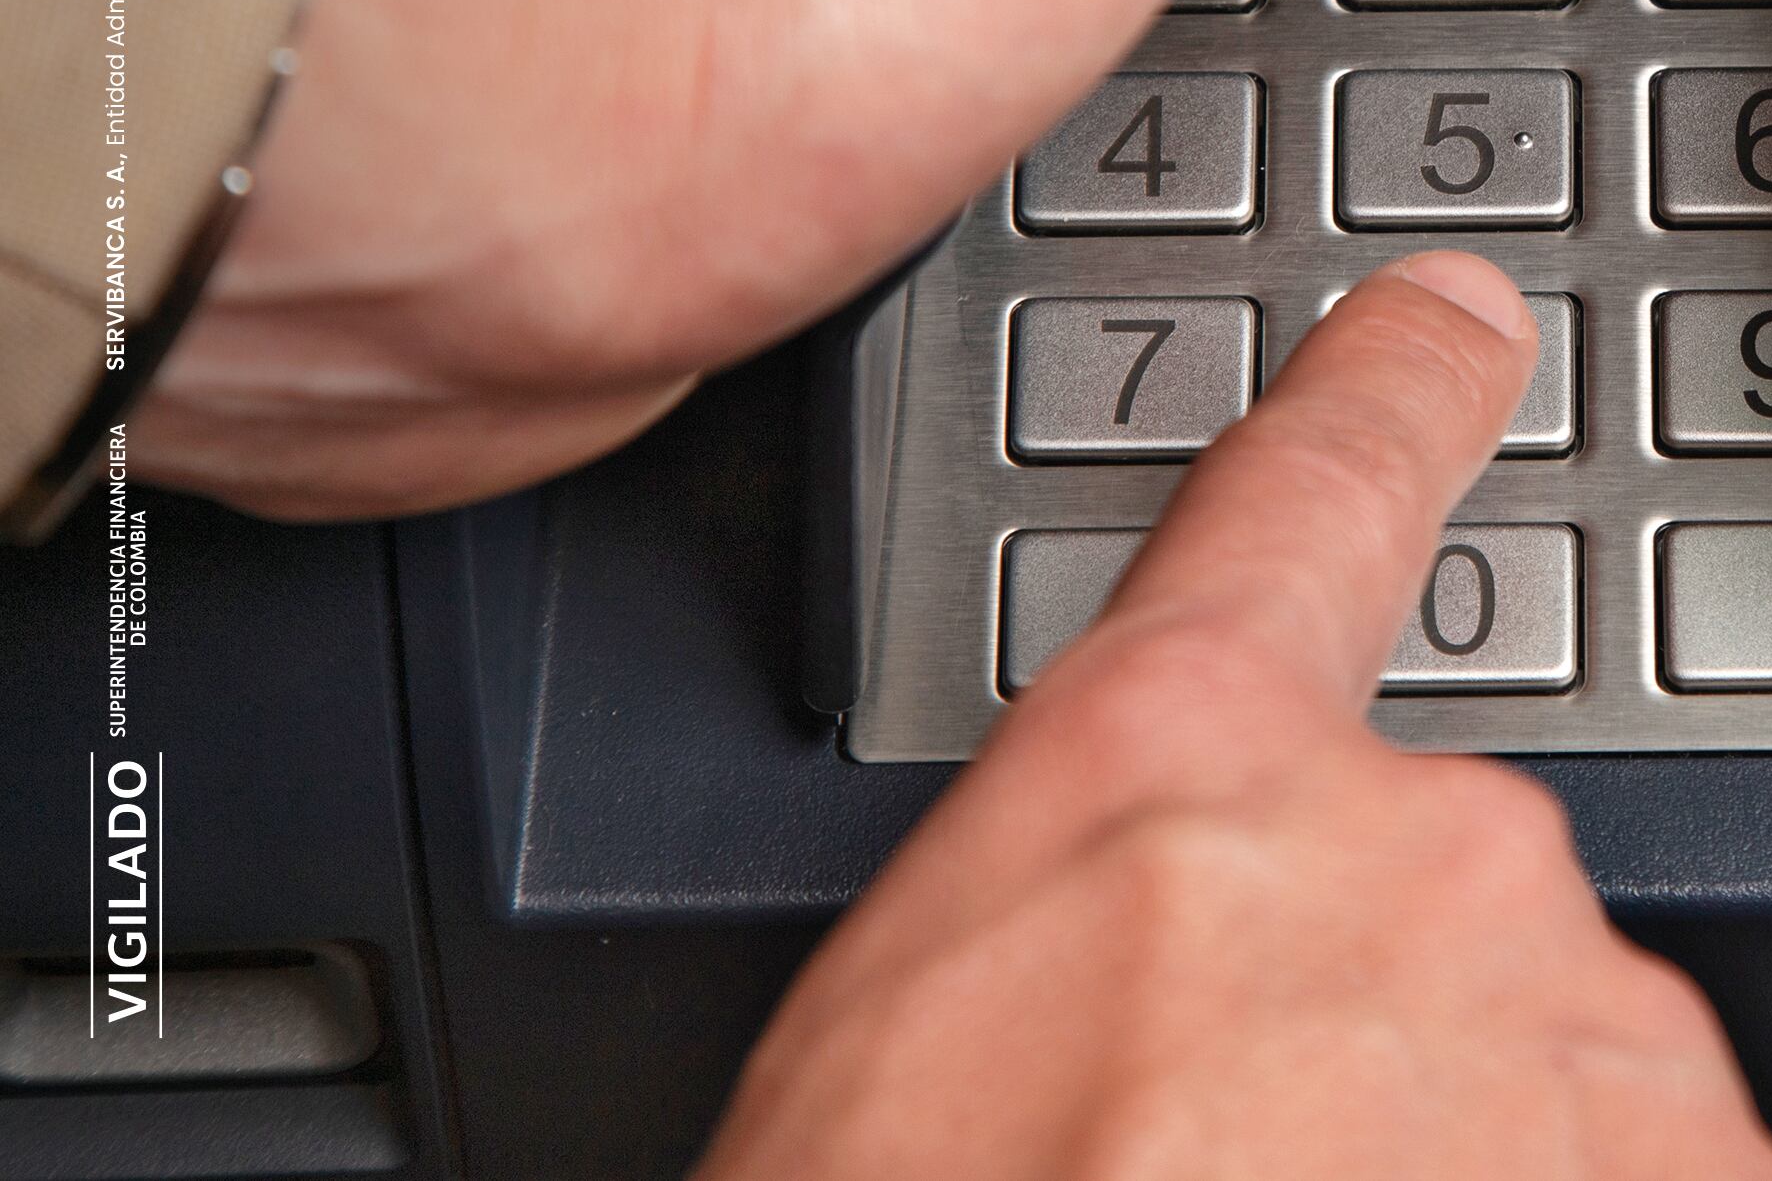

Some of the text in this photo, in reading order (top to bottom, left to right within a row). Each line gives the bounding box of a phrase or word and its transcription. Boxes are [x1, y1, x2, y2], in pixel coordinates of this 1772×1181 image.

[1097, 94, 1178, 198] 4
[1420, 92, 1496, 196] 5
[1101, 319, 1176, 426] 7
[1419, 543, 1496, 656] 0
